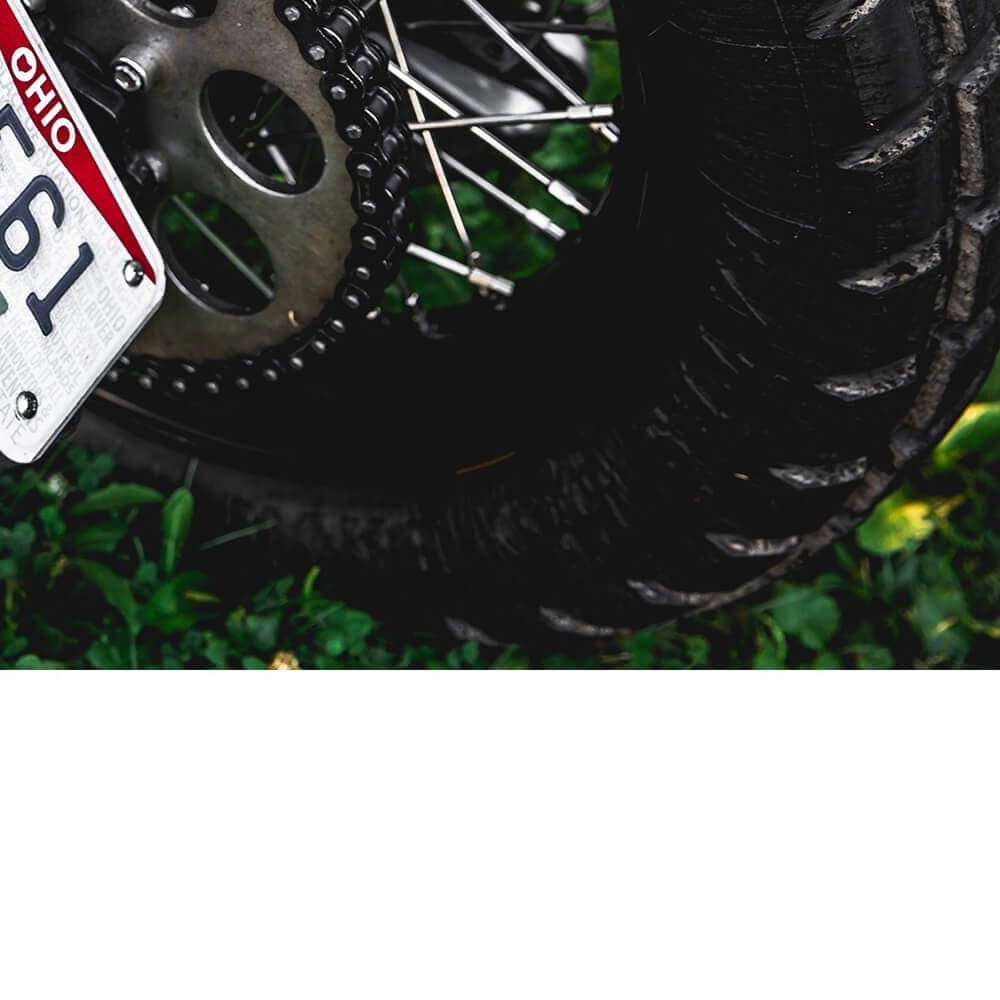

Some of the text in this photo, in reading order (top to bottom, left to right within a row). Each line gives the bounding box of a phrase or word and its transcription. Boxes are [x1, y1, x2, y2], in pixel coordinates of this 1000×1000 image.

[11, 47, 75, 152] OHIO
[37, 146, 86, 222] AVIATION
[84, 301, 114, 346] RIVER
[96, 285, 126, 332] OHIO
